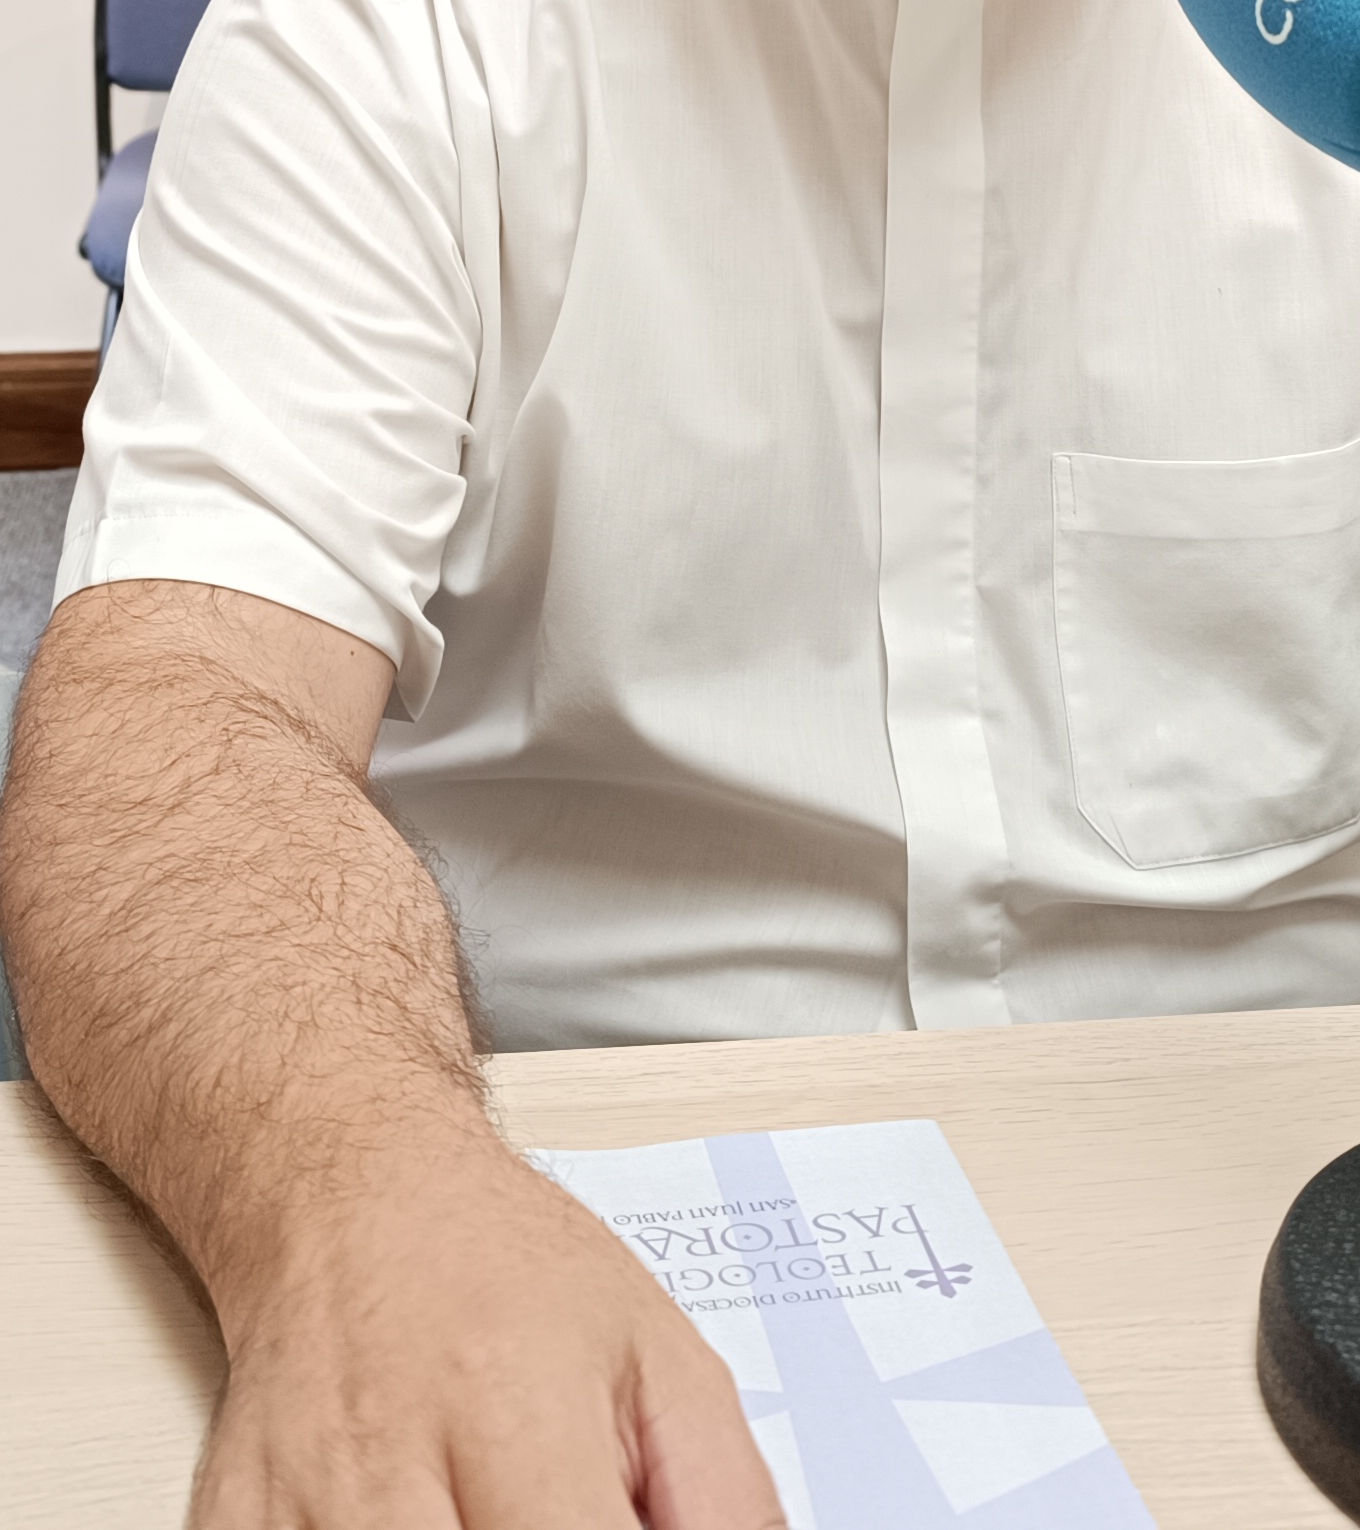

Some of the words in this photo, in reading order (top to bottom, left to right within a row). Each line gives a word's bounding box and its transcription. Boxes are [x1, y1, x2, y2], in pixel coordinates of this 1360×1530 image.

[612, 1209, 684, 1226] PABLO
[618, 1203, 930, 1262] PASTORA
[653, 1250, 892, 1302] TEOLOGÍ
[681, 1292, 777, 1313] DIOCESA
[782, 1279, 903, 1304] INSTITUTO
